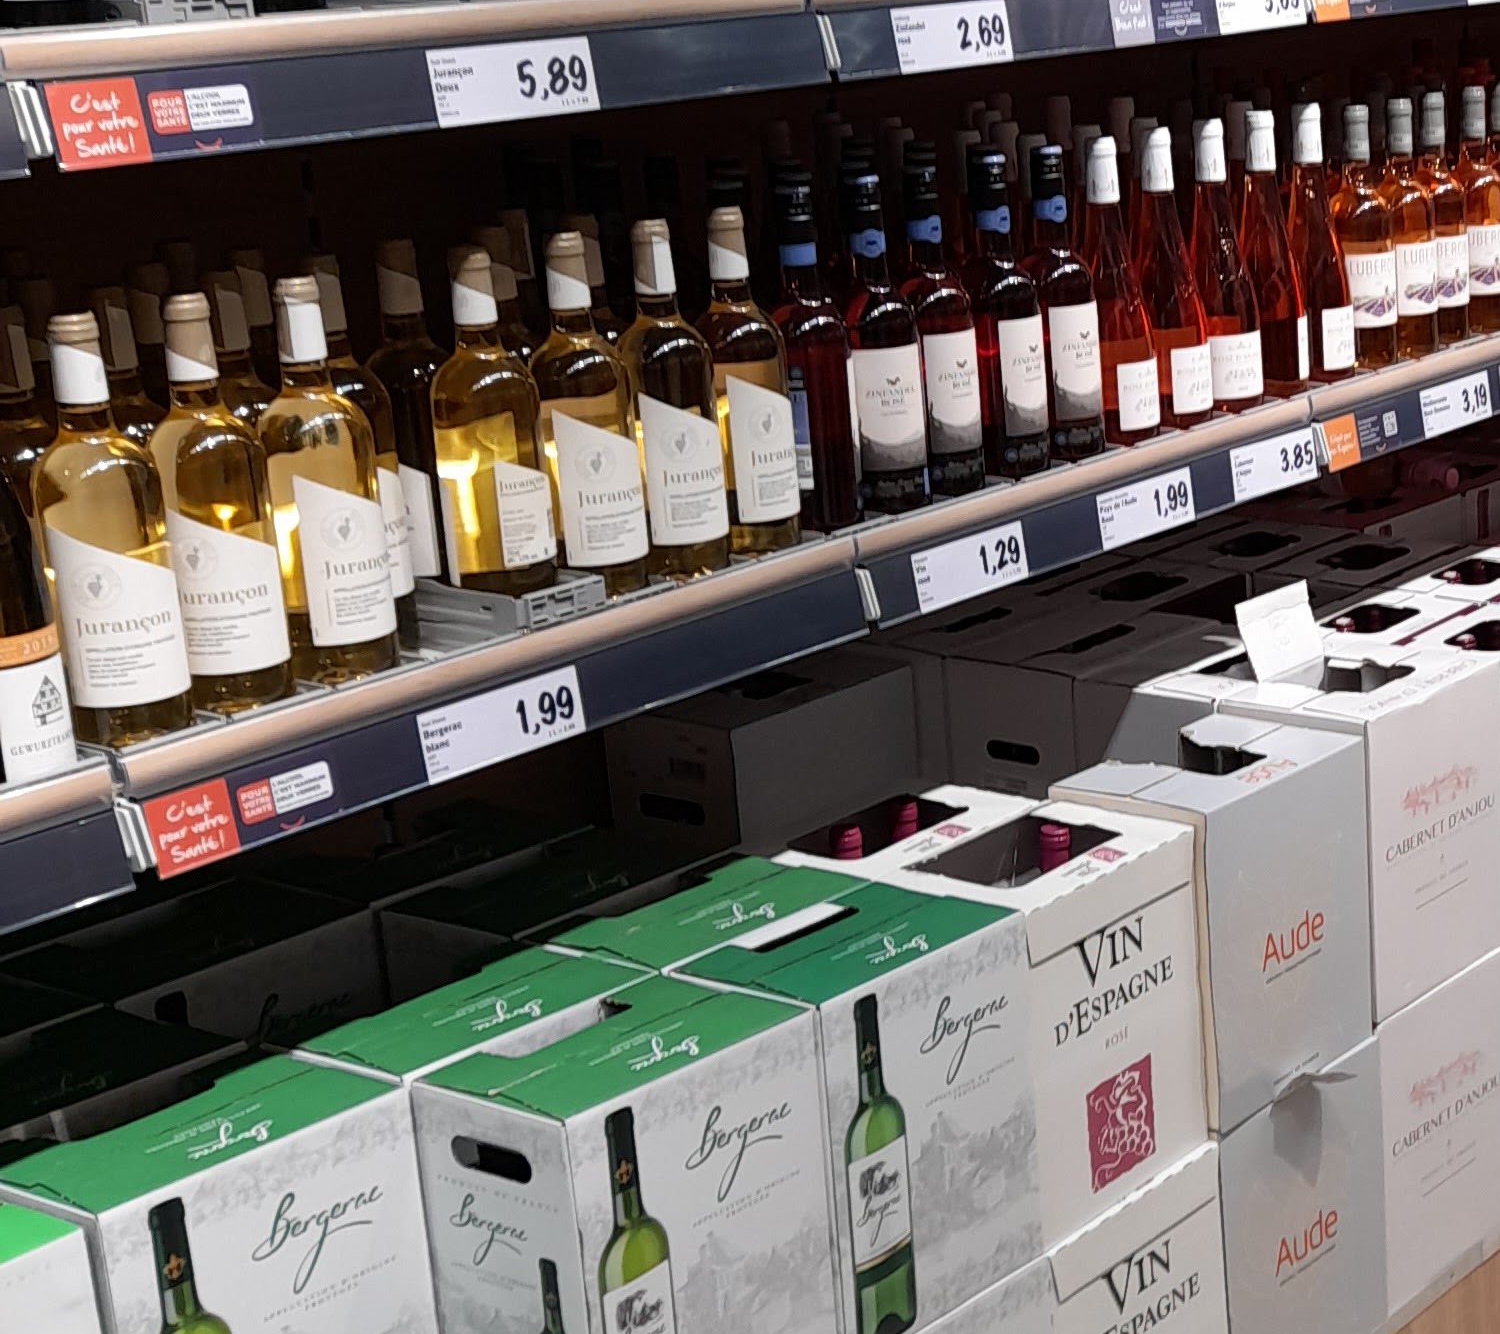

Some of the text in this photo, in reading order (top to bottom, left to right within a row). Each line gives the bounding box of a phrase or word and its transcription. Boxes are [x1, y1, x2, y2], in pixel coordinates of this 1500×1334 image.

[957, 13, 1005, 53] 2,69
[516, 54, 588, 101] 5,89
[70, 91, 121, 114] C'est
[151, 96, 183, 109] POUR
[154, 108, 185, 119] VOTRE
[62, 111, 139, 142] pour votre
[1461, 382, 1488, 414] 3,19
[1154, 480, 1188, 518] 1,99
[979, 534, 1021, 576] 1,29
[76, 608, 172, 638] Jurançon
[423, 720, 463, 741] Bergerac
[516, 685, 574, 736] 1,99
[166, 794, 213, 823] C'est
[240, 785, 269, 802] POUR
[243, 796, 271, 811] VOTRE
[158, 813, 229, 851] pour votre
[1386, 793, 1496, 863] CABERNET D'ANJOU
[1074, 916, 1145, 988] VIN
[1262, 910, 1325, 974] Aude
[1054, 956, 1175, 1048] D'ESPAGNE
[919, 992, 1010, 1086] Bergerac
[685, 1102, 792, 1203] Bergerac
[1392, 1107, 1452, 1157] CABERNET
[252, 1185, 384, 1295] Bergerac
[450, 1192, 528, 1267] Bergerac
[1275, 1208, 1339, 1277] Aude
[1100, 1238, 1172, 1315] VIN
